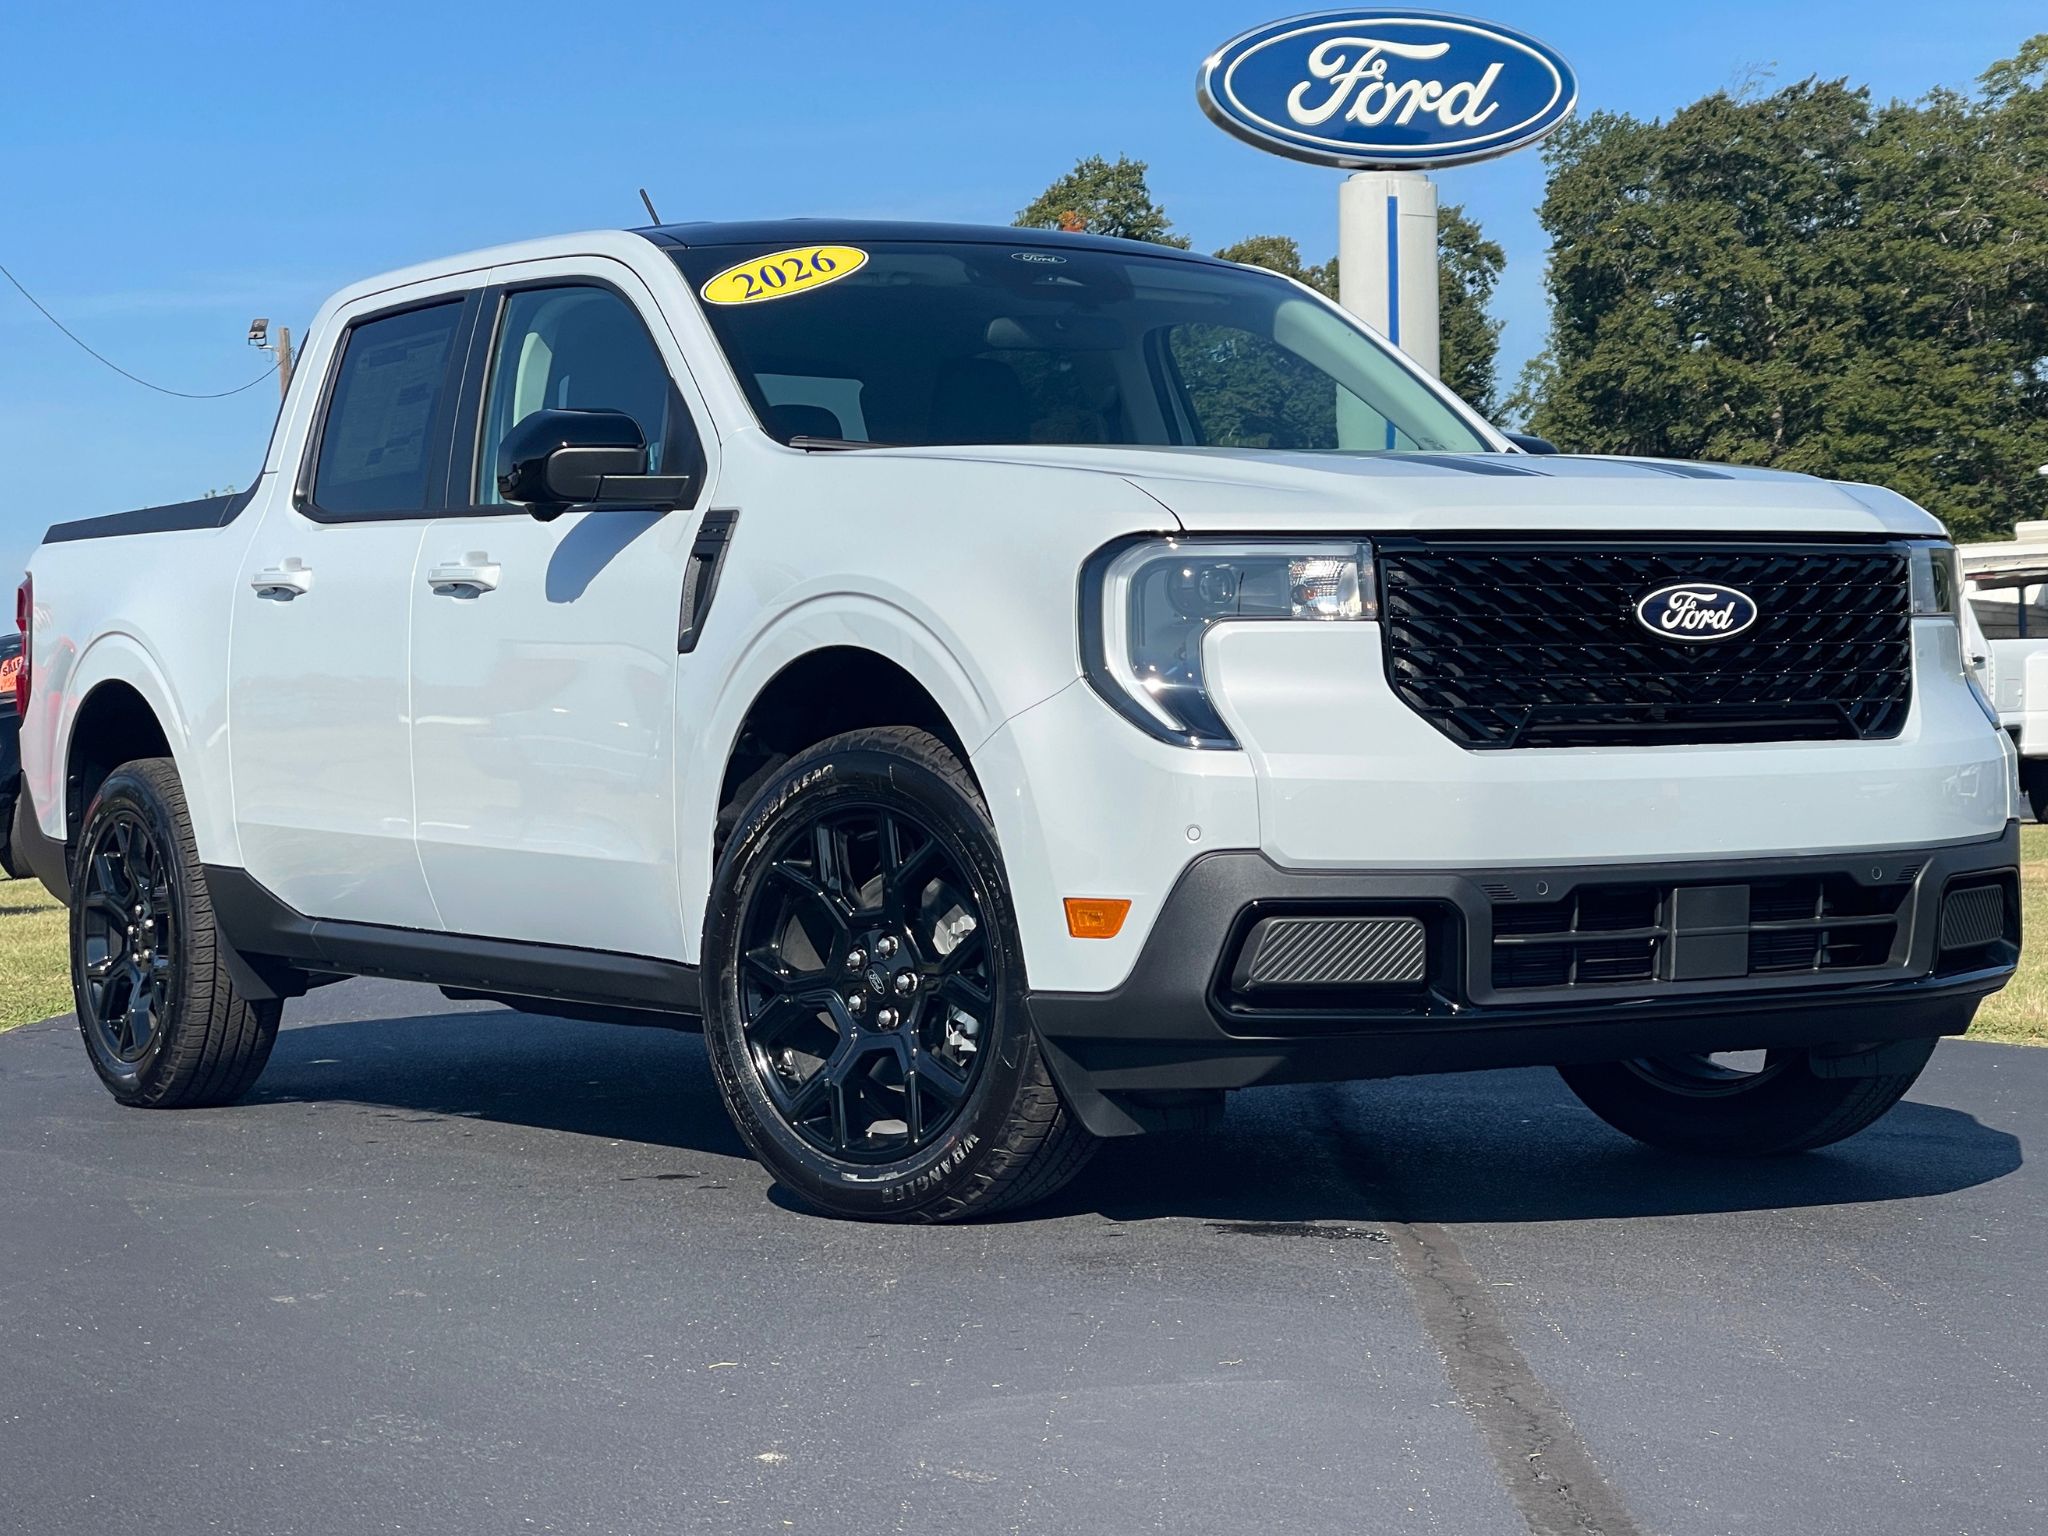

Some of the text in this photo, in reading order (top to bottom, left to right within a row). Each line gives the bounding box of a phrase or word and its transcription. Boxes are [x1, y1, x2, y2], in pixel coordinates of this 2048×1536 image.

[1287, 36, 1504, 127] Ford
[732, 249, 837, 299] 2026
[1661, 590, 1736, 630] Ford
